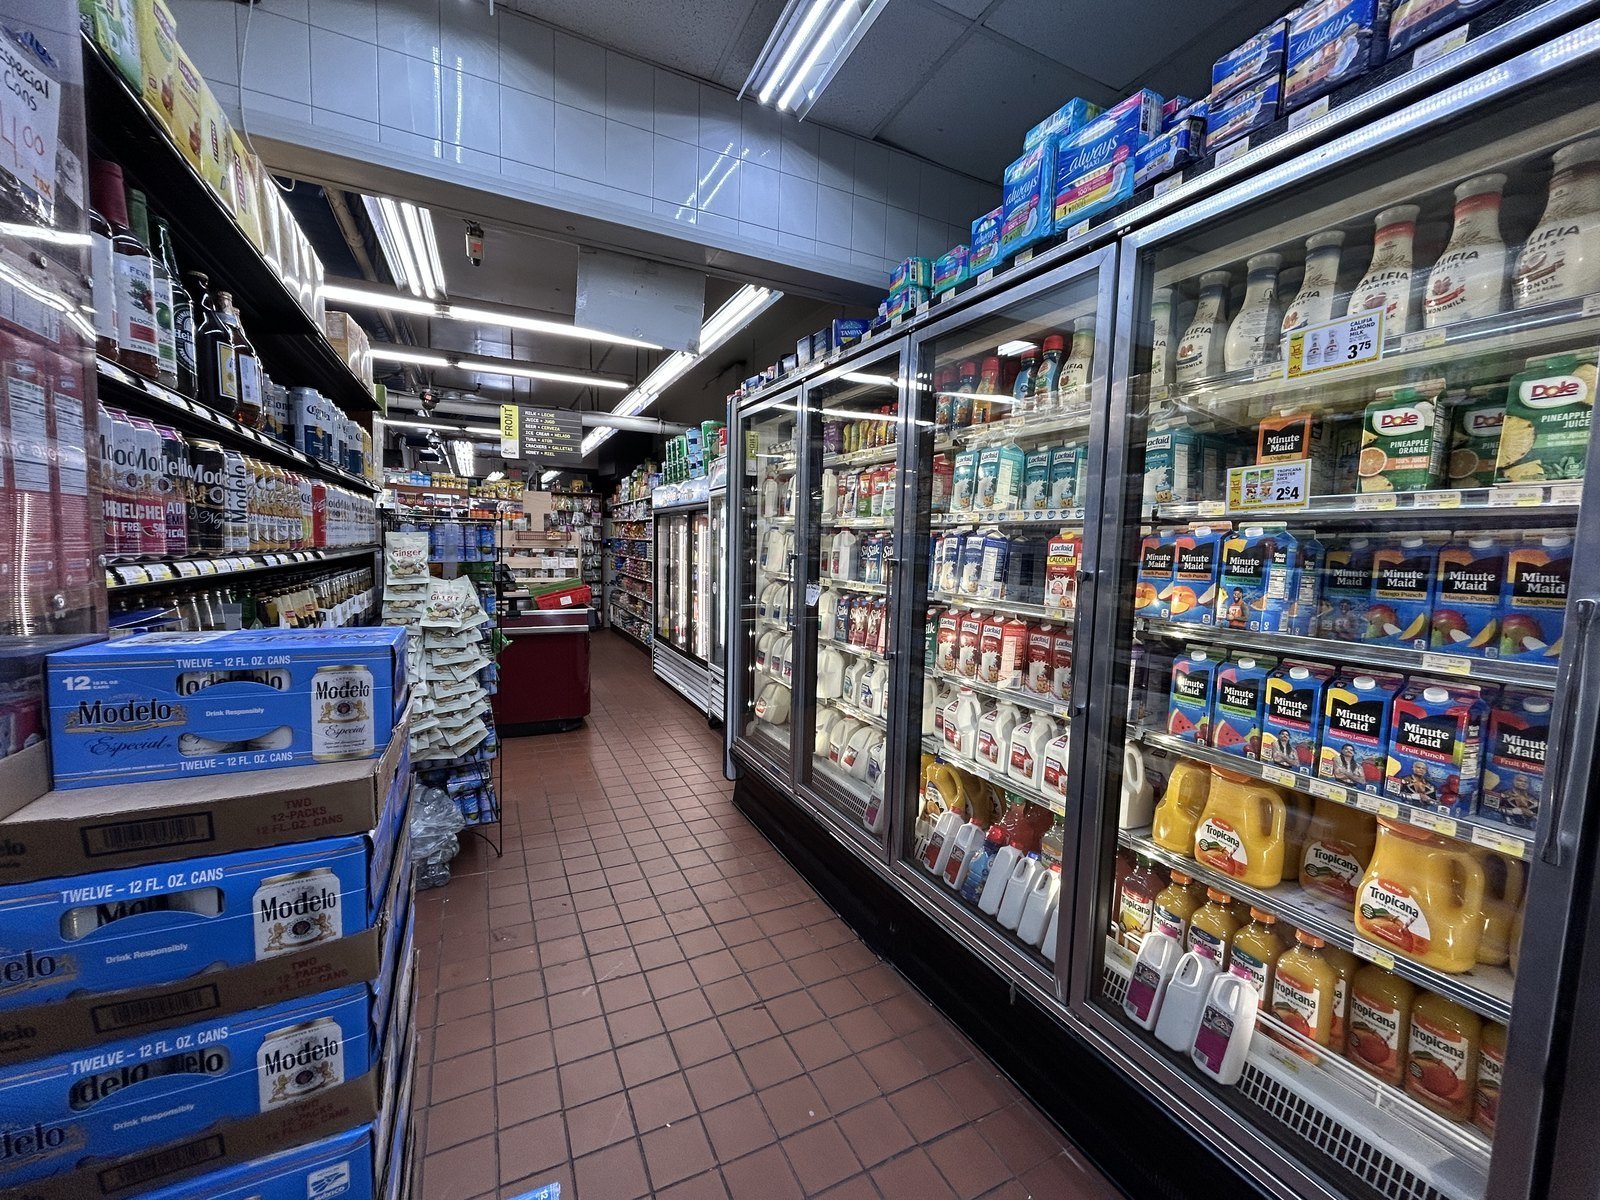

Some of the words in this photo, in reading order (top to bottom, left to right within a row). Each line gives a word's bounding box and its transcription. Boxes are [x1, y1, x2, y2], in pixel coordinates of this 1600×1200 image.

[1296, 11, 1353, 53] always
[1070, 136, 1119, 174] always
[1083, 159, 1100, 171] MAXI
[1006, 175, 1039, 206] always
[1350, 318, 1373, 327] CALIFIA
[1350, 322, 1375, 332] ALMOND
[1531, 379, 1580, 399] Dole
[505, 407, 513, 437] FRONT
[1381, 413, 1418, 428] Dole
[1541, 410, 1592, 423] PINEAPPLE
[1563, 418, 1591, 429] JUICE
[1267, 433, 1300, 445] Minute
[1390, 439, 1430, 449] PINEAPPLE
[1270, 443, 1294, 452] Maid
[1399, 446, 1429, 454] ORANGE
[981, 451, 999, 461] Lactaid
[1028, 456, 1048, 466] Lactaid
[1054, 451, 1075, 462] Lactaid
[392, 549, 421, 557] Ginger
[1051, 544, 1074, 554] Lactaid
[1146, 553, 1171, 561] Minute
[1181, 554, 1209, 563] Minute
[1229, 557, 1260, 566] Minute
[1148, 560, 1167, 568] Maid
[1184, 562, 1204, 570] Maid
[1231, 565, 1254, 574] Maid
[1333, 569, 1369, 578] Minute
[1383, 569, 1424, 579] Minute
[1449, 571, 1496, 582] Minute
[1336, 577, 1363, 586] Maid
[1386, 578, 1417, 588] Maid
[1454, 581, 1488, 591] Maid
[1526, 582, 1566, 594] Maid
[1378, 591, 1400, 599] Mango
[984, 626, 1001, 635] Lactaid
[1031, 634, 1049, 645] Lactaid
[176, 658, 213, 668] TWELVE
[224, 658, 234, 667] 12
[236, 657, 249, 666] FL.
[251, 656, 265, 665] OZ.
[267, 655, 291, 665] CANS
[62, 675, 91, 691] 12
[316, 680, 370, 700] Modelo
[1179, 687, 1200, 696] Maid
[1224, 686, 1254, 699] Minute
[1226, 695, 1249, 706] Maid
[1273, 696, 1308, 711] Minute
[78, 698, 172, 725] Modelo
[225, 707, 265, 717] Responsibly
[1277, 705, 1302, 718] Maid
[1336, 707, 1376, 724] Minute
[324, 724, 366, 738] Especial
[1339, 718, 1369, 732] Maid
[1403, 722, 1450, 741] Minute
[84, 736, 168, 757] Especial
[1407, 733, 1441, 749] Maid
[1401, 745, 1419, 756] Fruit
[1420, 750, 1445, 761] Punch
[1507, 745, 1545, 761] Maid
[180, 760, 216, 771] TWELVE
[226, 757, 237, 766] 12
[238, 755, 251, 765] FL.
[254, 754, 267, 764] OZ.
[270, 751, 293, 762] CANS
[1500, 757, 1521, 769] Fruit
[286, 798, 312, 809] TWO
[271, 806, 327, 822] 12-PACKS
[313, 814, 344, 827] CANS
[1205, 824, 1240, 848] Tropicana
[1314, 847, 1359, 874] Tropicana
[61, 885, 113, 904] TWELVE
[128, 880, 143, 895] 12
[145, 877, 165, 892] FL.
[167, 873, 187, 888] OZ.
[190, 867, 225, 885] CANS
[261, 887, 337, 923] Modelo
[1369, 885, 1419, 919] Tropicana
[105, 952, 133, 965] Drink
[134, 943, 188, 961] Responsibly
[1274, 978, 1316, 1009] Tropicana
[1351, 997, 1396, 1031] Tropicana
[1412, 1024, 1465, 1060] Tropicana
[71, 1052, 124, 1076] TWELVE
[139, 1043, 153, 1059] 12
[155, 1039, 174, 1056] FL.
[176, 1034, 195, 1050] OZ.
[197, 1026, 229, 1045] CANS
[264, 1036, 339, 1076] Modelo
[113, 1117, 139, 1131] Drink
[140, 1103, 195, 1124] Responsibly
